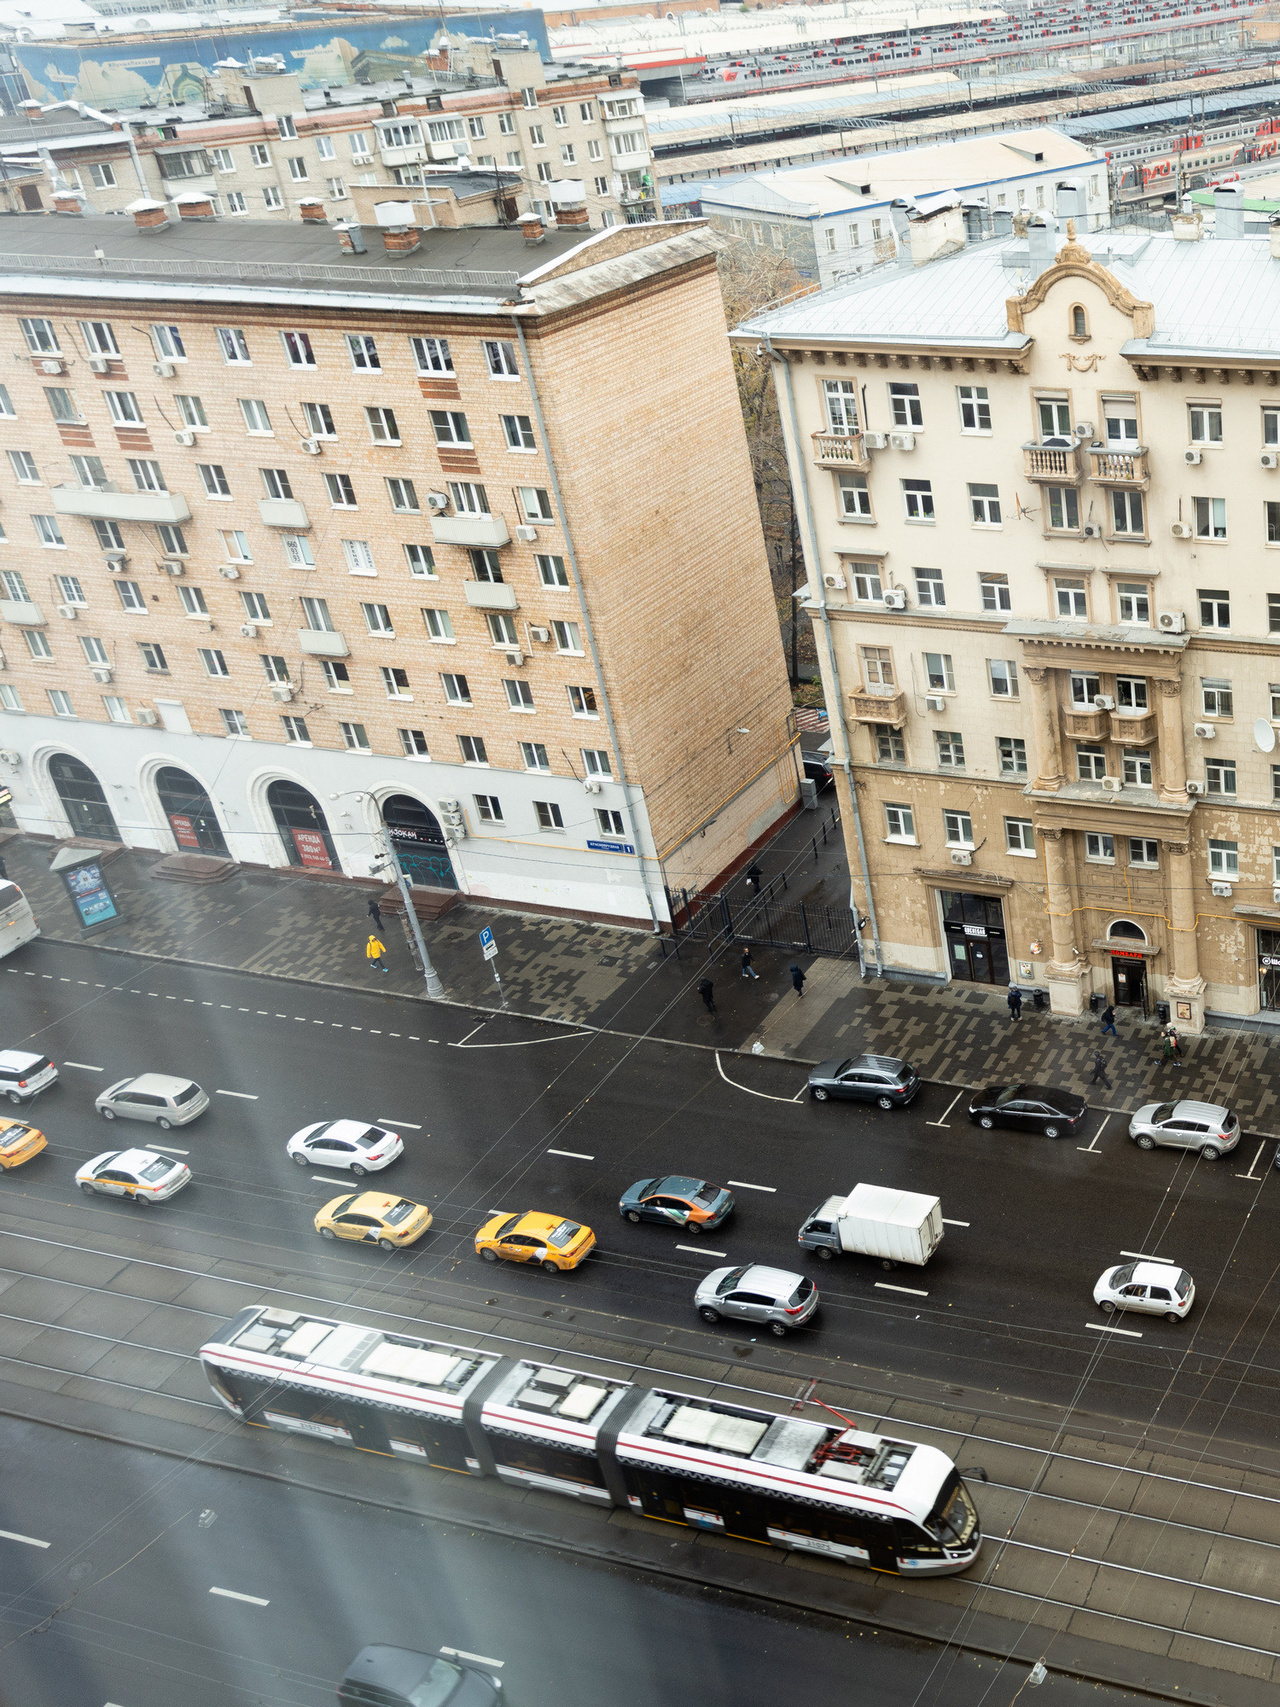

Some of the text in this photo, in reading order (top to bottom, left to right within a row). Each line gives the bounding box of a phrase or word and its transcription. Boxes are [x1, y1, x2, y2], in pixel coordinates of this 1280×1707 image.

[174, 819, 191, 827] АРЕНДА
[297, 833, 321, 843] АРЕНДА
[1110, 949, 1144, 959] ЛОМБАРД
